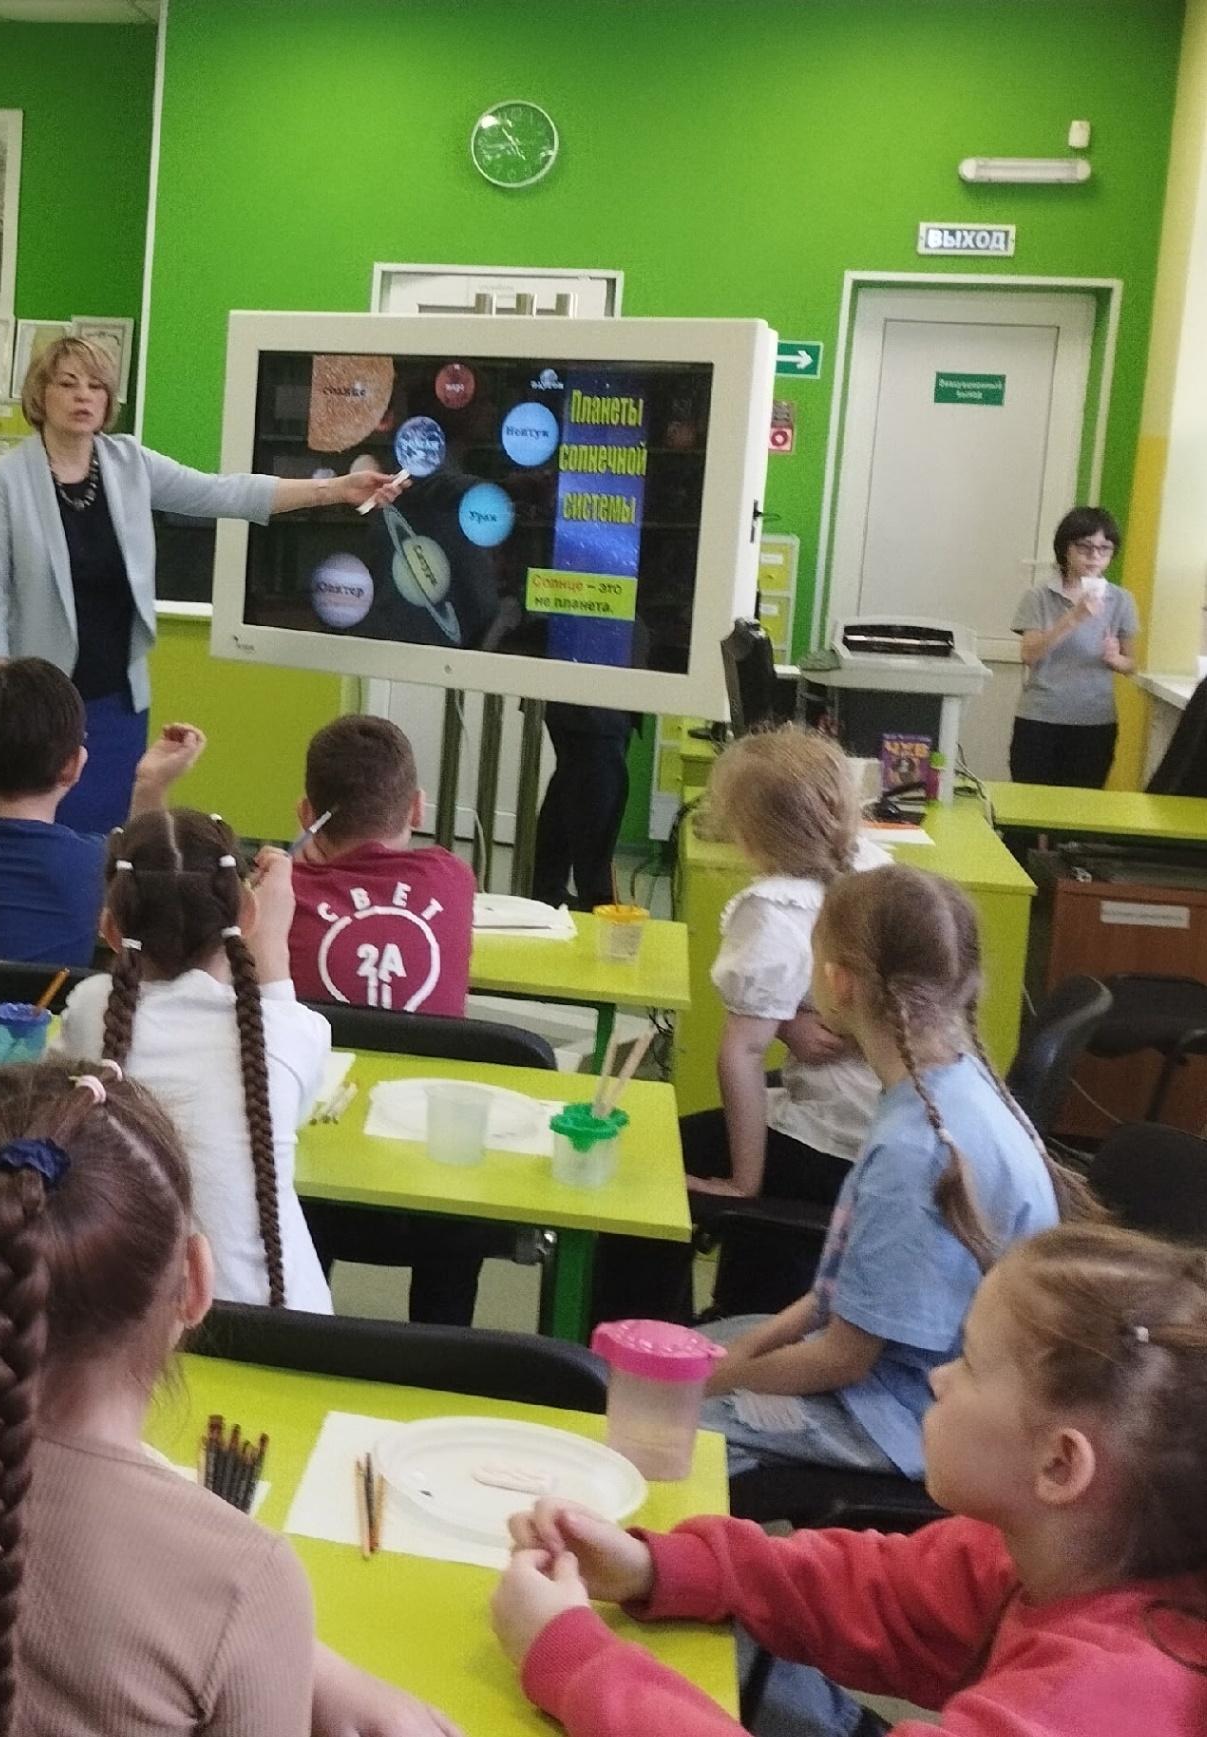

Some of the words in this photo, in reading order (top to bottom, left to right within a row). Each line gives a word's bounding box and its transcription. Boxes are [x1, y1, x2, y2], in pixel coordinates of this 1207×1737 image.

[927, 228, 1005, 251] ВЫХОД
[571, 389, 644, 427] Планеты
[558, 442, 648, 476] солнечной
[562, 492, 636, 524] системы
[532, 574, 584, 593] Солнце
[598, 583, 623, 595] это
[535, 597, 551, 608] не
[317, 881, 444, 922] СВЕТ
